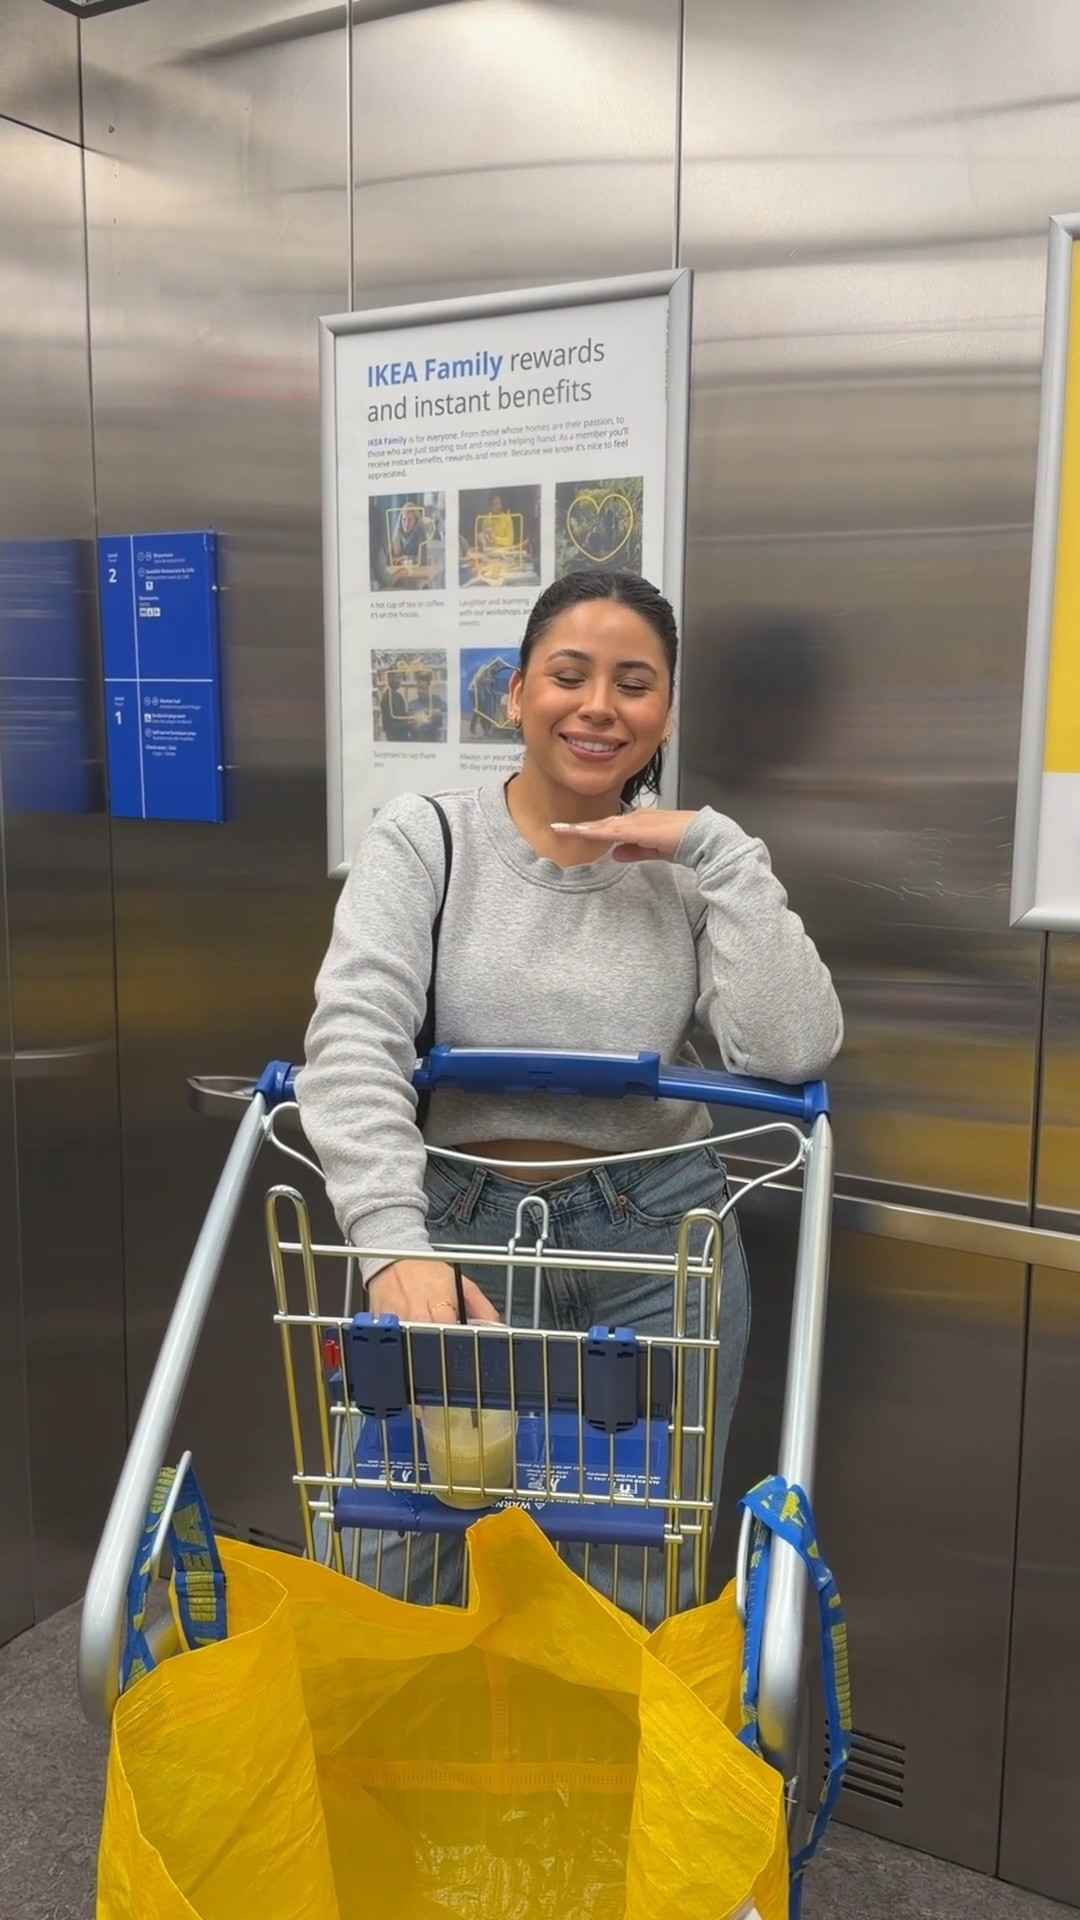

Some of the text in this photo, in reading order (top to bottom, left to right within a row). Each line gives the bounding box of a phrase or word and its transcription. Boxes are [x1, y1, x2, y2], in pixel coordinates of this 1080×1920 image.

[368, 338, 605, 388] IKEA Family rewards
[368, 379, 592, 422] and instant benefits
[368, 438, 383, 446] IKEA
[384, 436, 407, 446] Family
[416, 434, 425, 442] for
[461, 430, 479, 438] From
[480, 428, 500, 437] those
[501, 426, 524, 435] whose
[525, 424, 550, 432] homes
[565, 420, 581, 429] their
[368, 449, 385, 458] those
[387, 448, 400, 456] who
[414, 446, 427, 456] just
[428, 444, 454, 453] starting
[469, 440, 482, 449] and
[484, 439, 501, 448] need
[508, 436, 535, 446] helping
[575, 430, 607, 439] member
[368, 461, 390, 469] receive
[391, 458, 414, 466] instant
[445, 453, 473, 462] rewards
[475, 452, 488, 460] and
[511, 448, 541, 457] Because
[555, 445, 574, 453] know
[587, 442, 601, 450] nice
[614, 439, 628, 448] feel
[368, 470, 406, 480] appreciated.
[108, 568, 117, 583] 2
[459, 599, 486, 608] Laughter
[502, 598, 529, 606] learning
[115, 711, 121, 725] 1
[460, 763, 481, 771] 90-day
[482, 763, 497, 771] price
